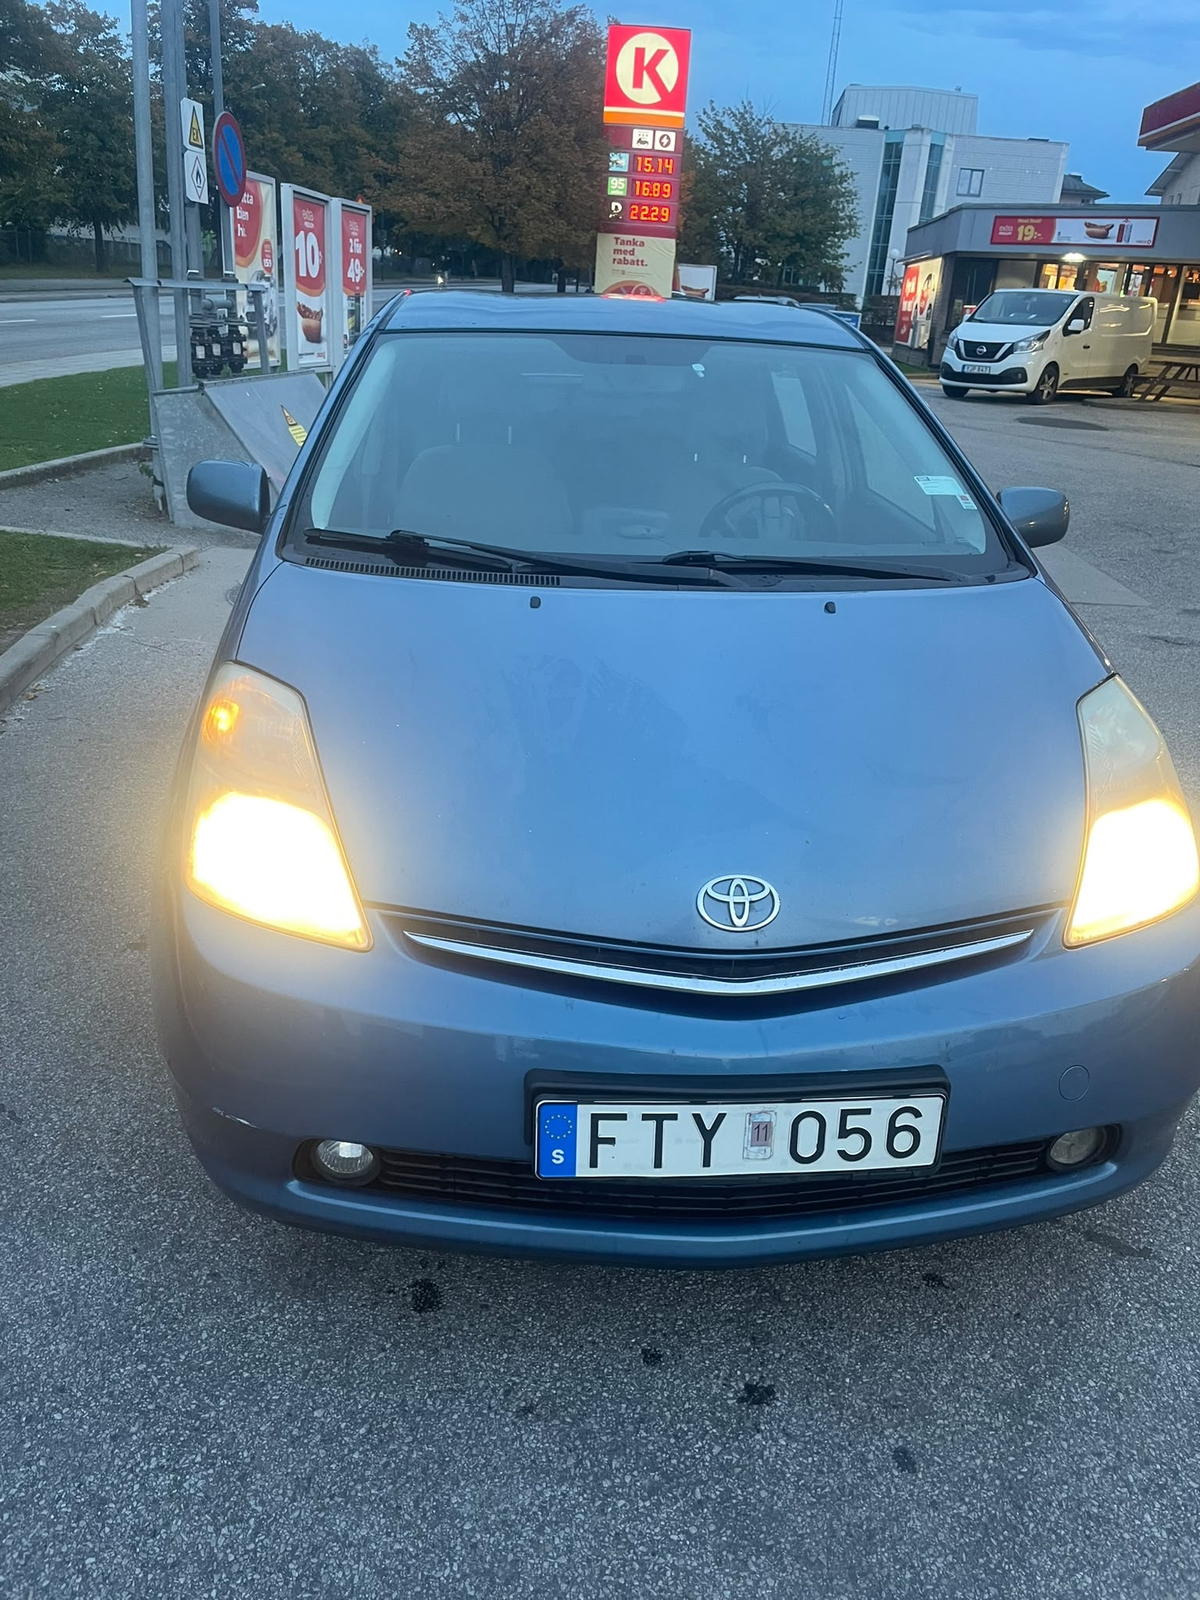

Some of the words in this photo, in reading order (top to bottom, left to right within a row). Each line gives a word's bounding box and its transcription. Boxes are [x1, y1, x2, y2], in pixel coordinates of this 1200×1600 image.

[631, 46, 671, 101] K
[192, 127, 201, 143] EX
[636, 156, 674, 174] 15.14
[610, 178, 625, 190] 95
[634, 180, 672, 198] 16.89
[629, 204, 670, 222] 22.29
[349, 238, 354, 253] 2
[613, 237, 645, 248] Tanka
[612, 247, 635, 257] med
[612, 257, 648, 267] rabatt.
[589, 1112, 727, 1169] FTY
[788, 1105, 924, 1165] 056
[753, 1123, 769, 1142] 11
[551, 1148, 565, 1165] S
